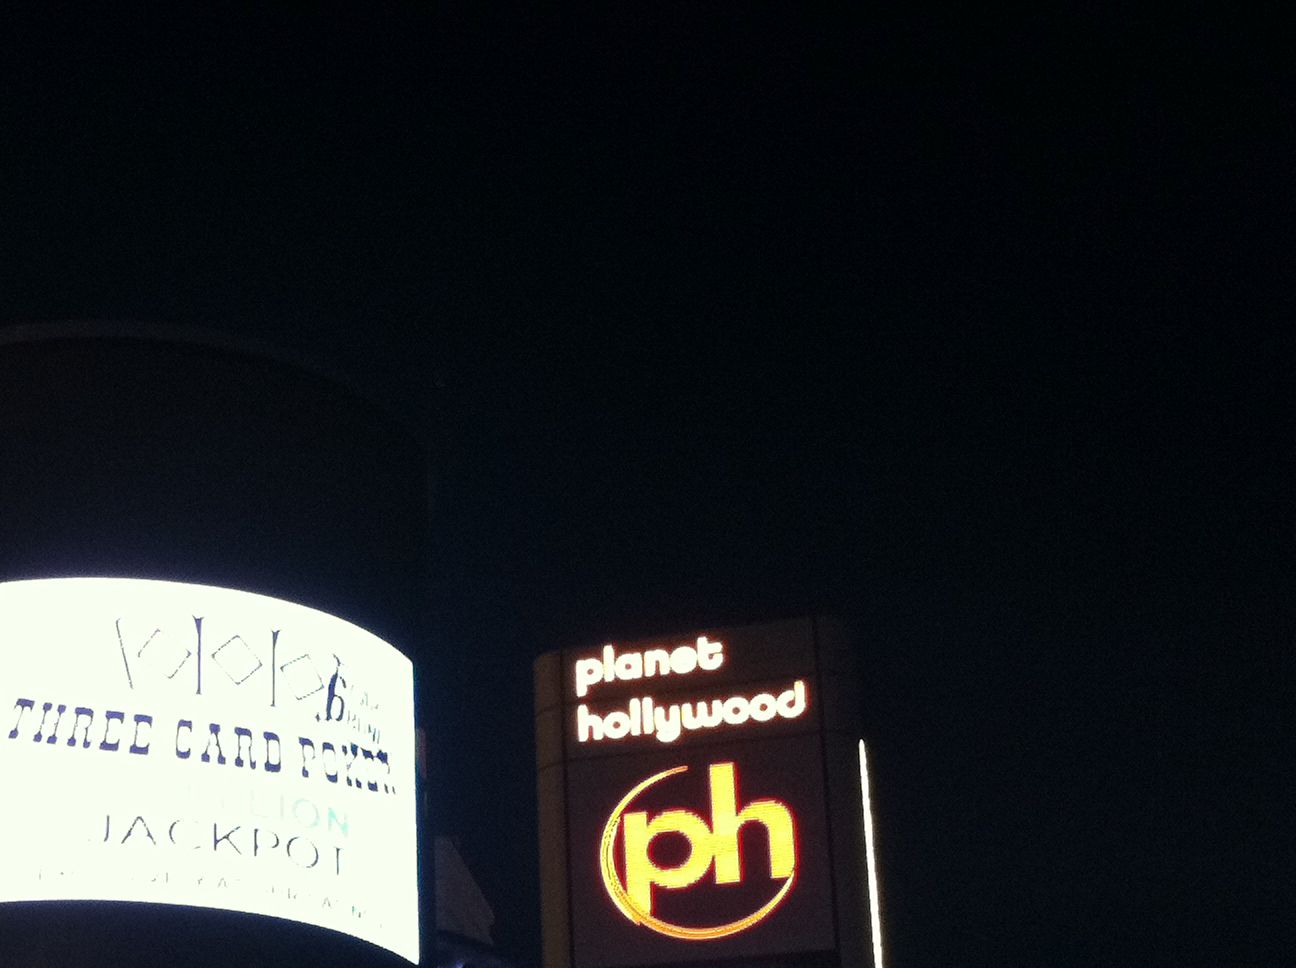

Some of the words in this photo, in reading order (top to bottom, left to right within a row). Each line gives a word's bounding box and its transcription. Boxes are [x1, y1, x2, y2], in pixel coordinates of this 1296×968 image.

[575, 635, 724, 698] planet
[8, 698, 154, 756] THREE
[175, 719, 283, 774] CARD
[576, 679, 807, 744] hollywood
[103, 813, 346, 876] JACKPOT
[622, 761, 796, 918] ph
